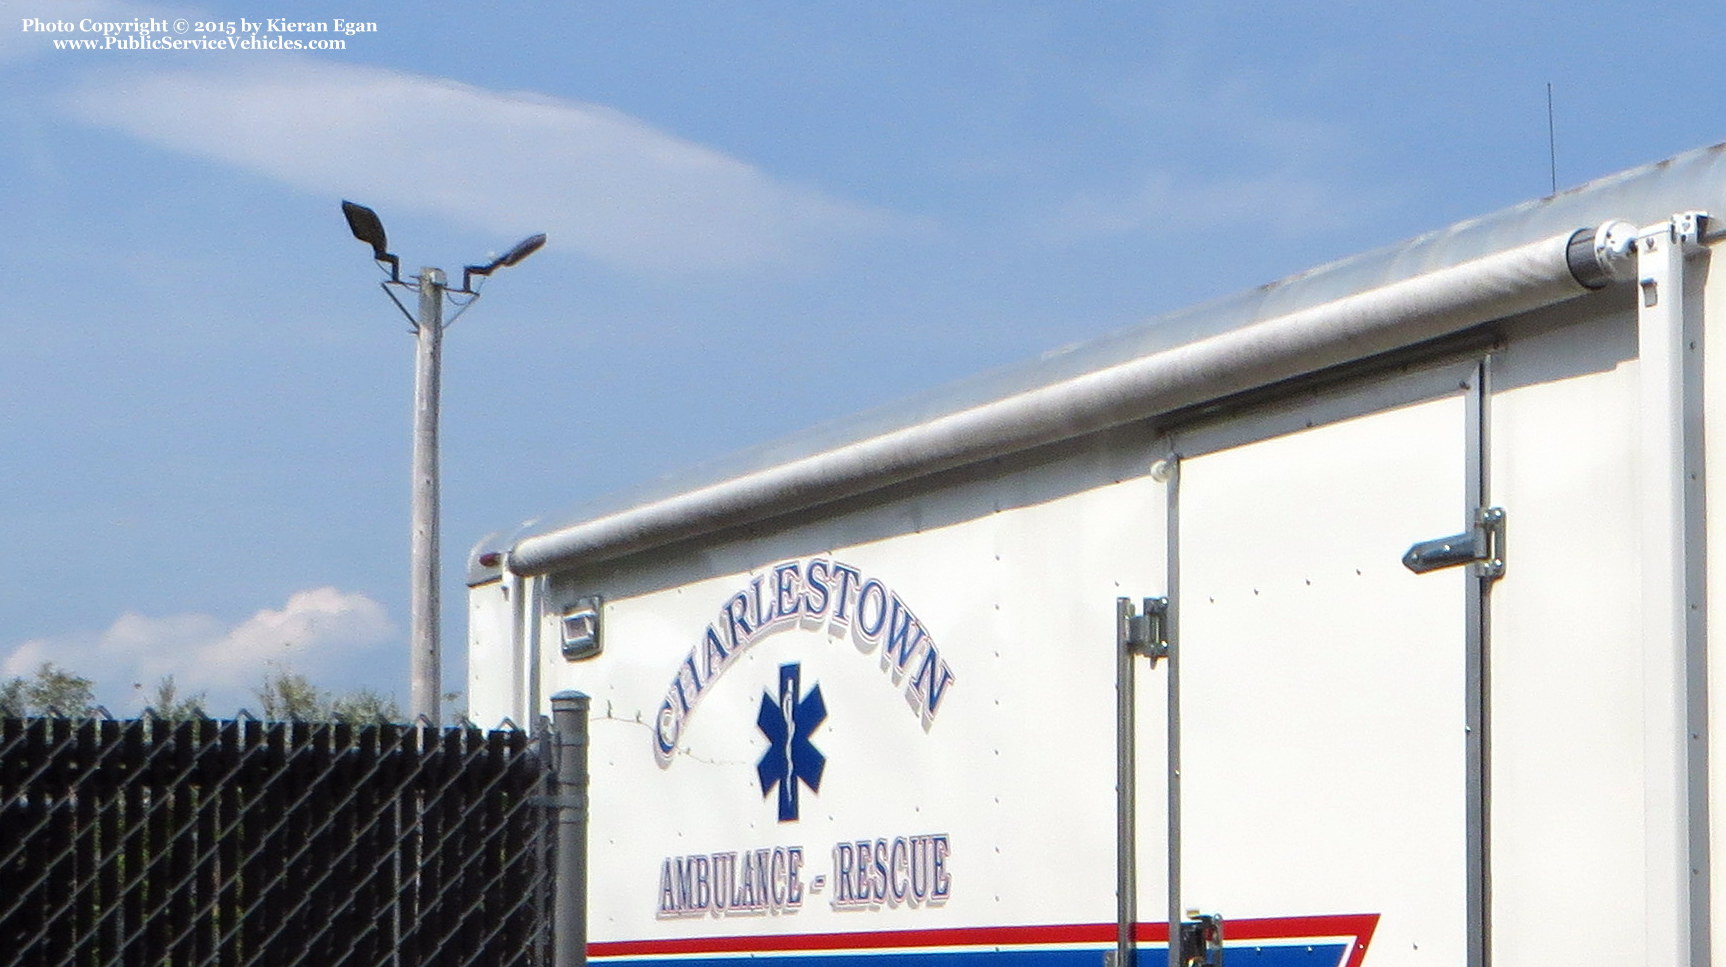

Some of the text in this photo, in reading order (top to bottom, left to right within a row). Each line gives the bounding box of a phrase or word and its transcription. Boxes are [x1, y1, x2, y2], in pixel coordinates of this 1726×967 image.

[653, 557, 956, 768] CHARLESTOWN
[656, 845, 804, 920] AMBULANCE
[830, 833, 952, 912] RESCUE
